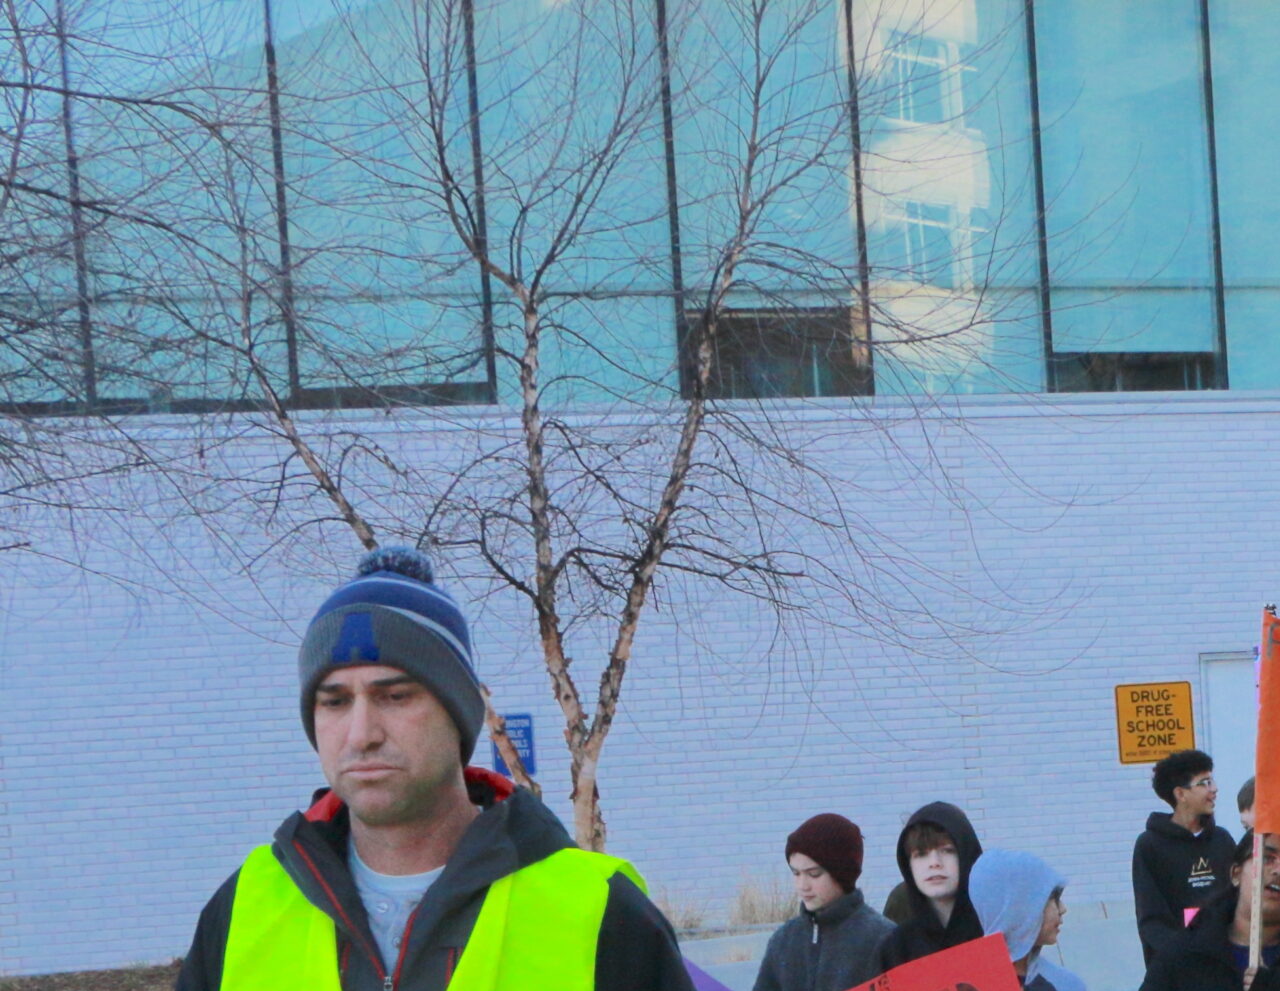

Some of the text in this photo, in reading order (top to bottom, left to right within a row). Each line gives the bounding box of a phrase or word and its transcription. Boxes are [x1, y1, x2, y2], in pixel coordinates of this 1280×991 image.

[332, 612, 380, 662] A
[1130, 689, 1176, 703] DRUG-
[1135, 703, 1173, 717] FREE
[1126, 718, 1185, 733] SCHOOL
[1137, 733, 1176, 748] ZONE
